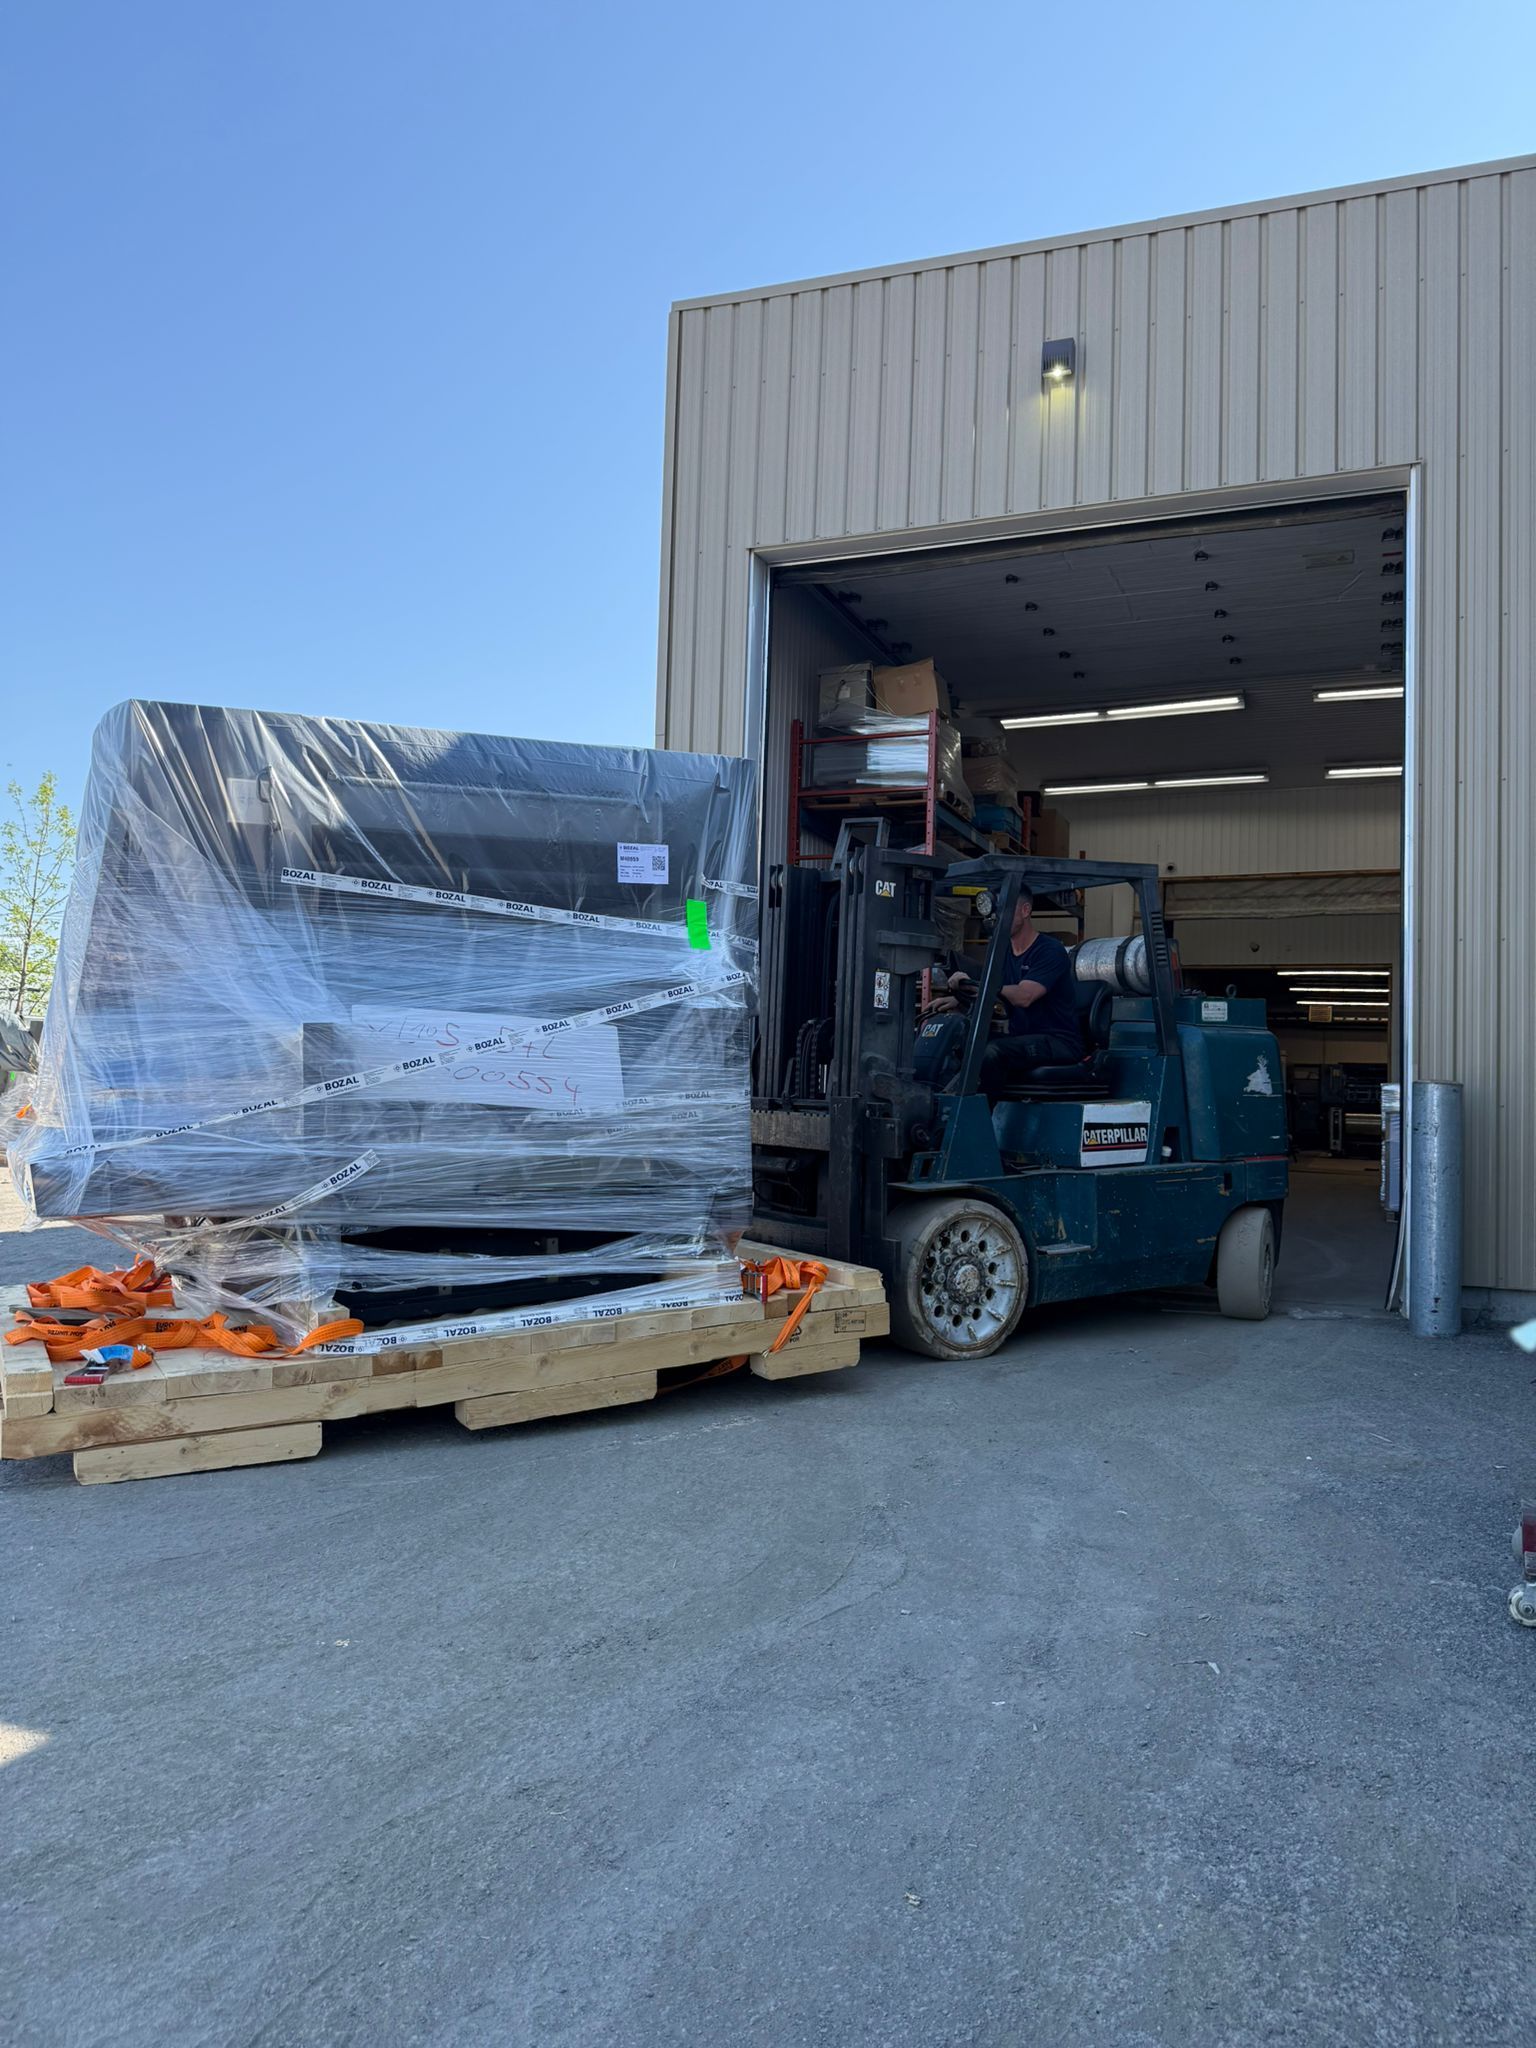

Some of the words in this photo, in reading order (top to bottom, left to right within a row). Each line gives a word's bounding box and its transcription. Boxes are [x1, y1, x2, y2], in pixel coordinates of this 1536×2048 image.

[875, 879, 897, 898] CAT
[282, 868, 317, 881] BOZAL
[361, 880, 393, 892] BOZAL
[435, 891, 466, 903] BOZAL
[506, 902, 535, 914] BOZAL
[572, 912, 600, 923] BOZAL
[636, 921, 663, 931] BOZAL
[324, 1075, 360, 1092] BOZAL
[402, 1055, 436, 1071] BOZAL
[474, 1036, 506, 1051] BOZAL
[541, 1019, 571, 1034] BOZAL
[605, 1002, 634, 1015] BOZAL
[667, 985, 695, 998] BOZAL
[922, 1023, 944, 1037] CAT
[685, 1090, 711, 1100] BOZAL
[671, 1110, 699, 1121] BOZAL
[1083, 1127, 1148, 1145] CATERPILLAR
[328, 1162, 362, 1186] BOZAL
[319, 1343, 355, 1353] BOZAL
[443, 1326, 477, 1337] BOZAL
[520, 1315, 552, 1327] BOZAL
[592, 1307, 623, 1318] BOZAL
